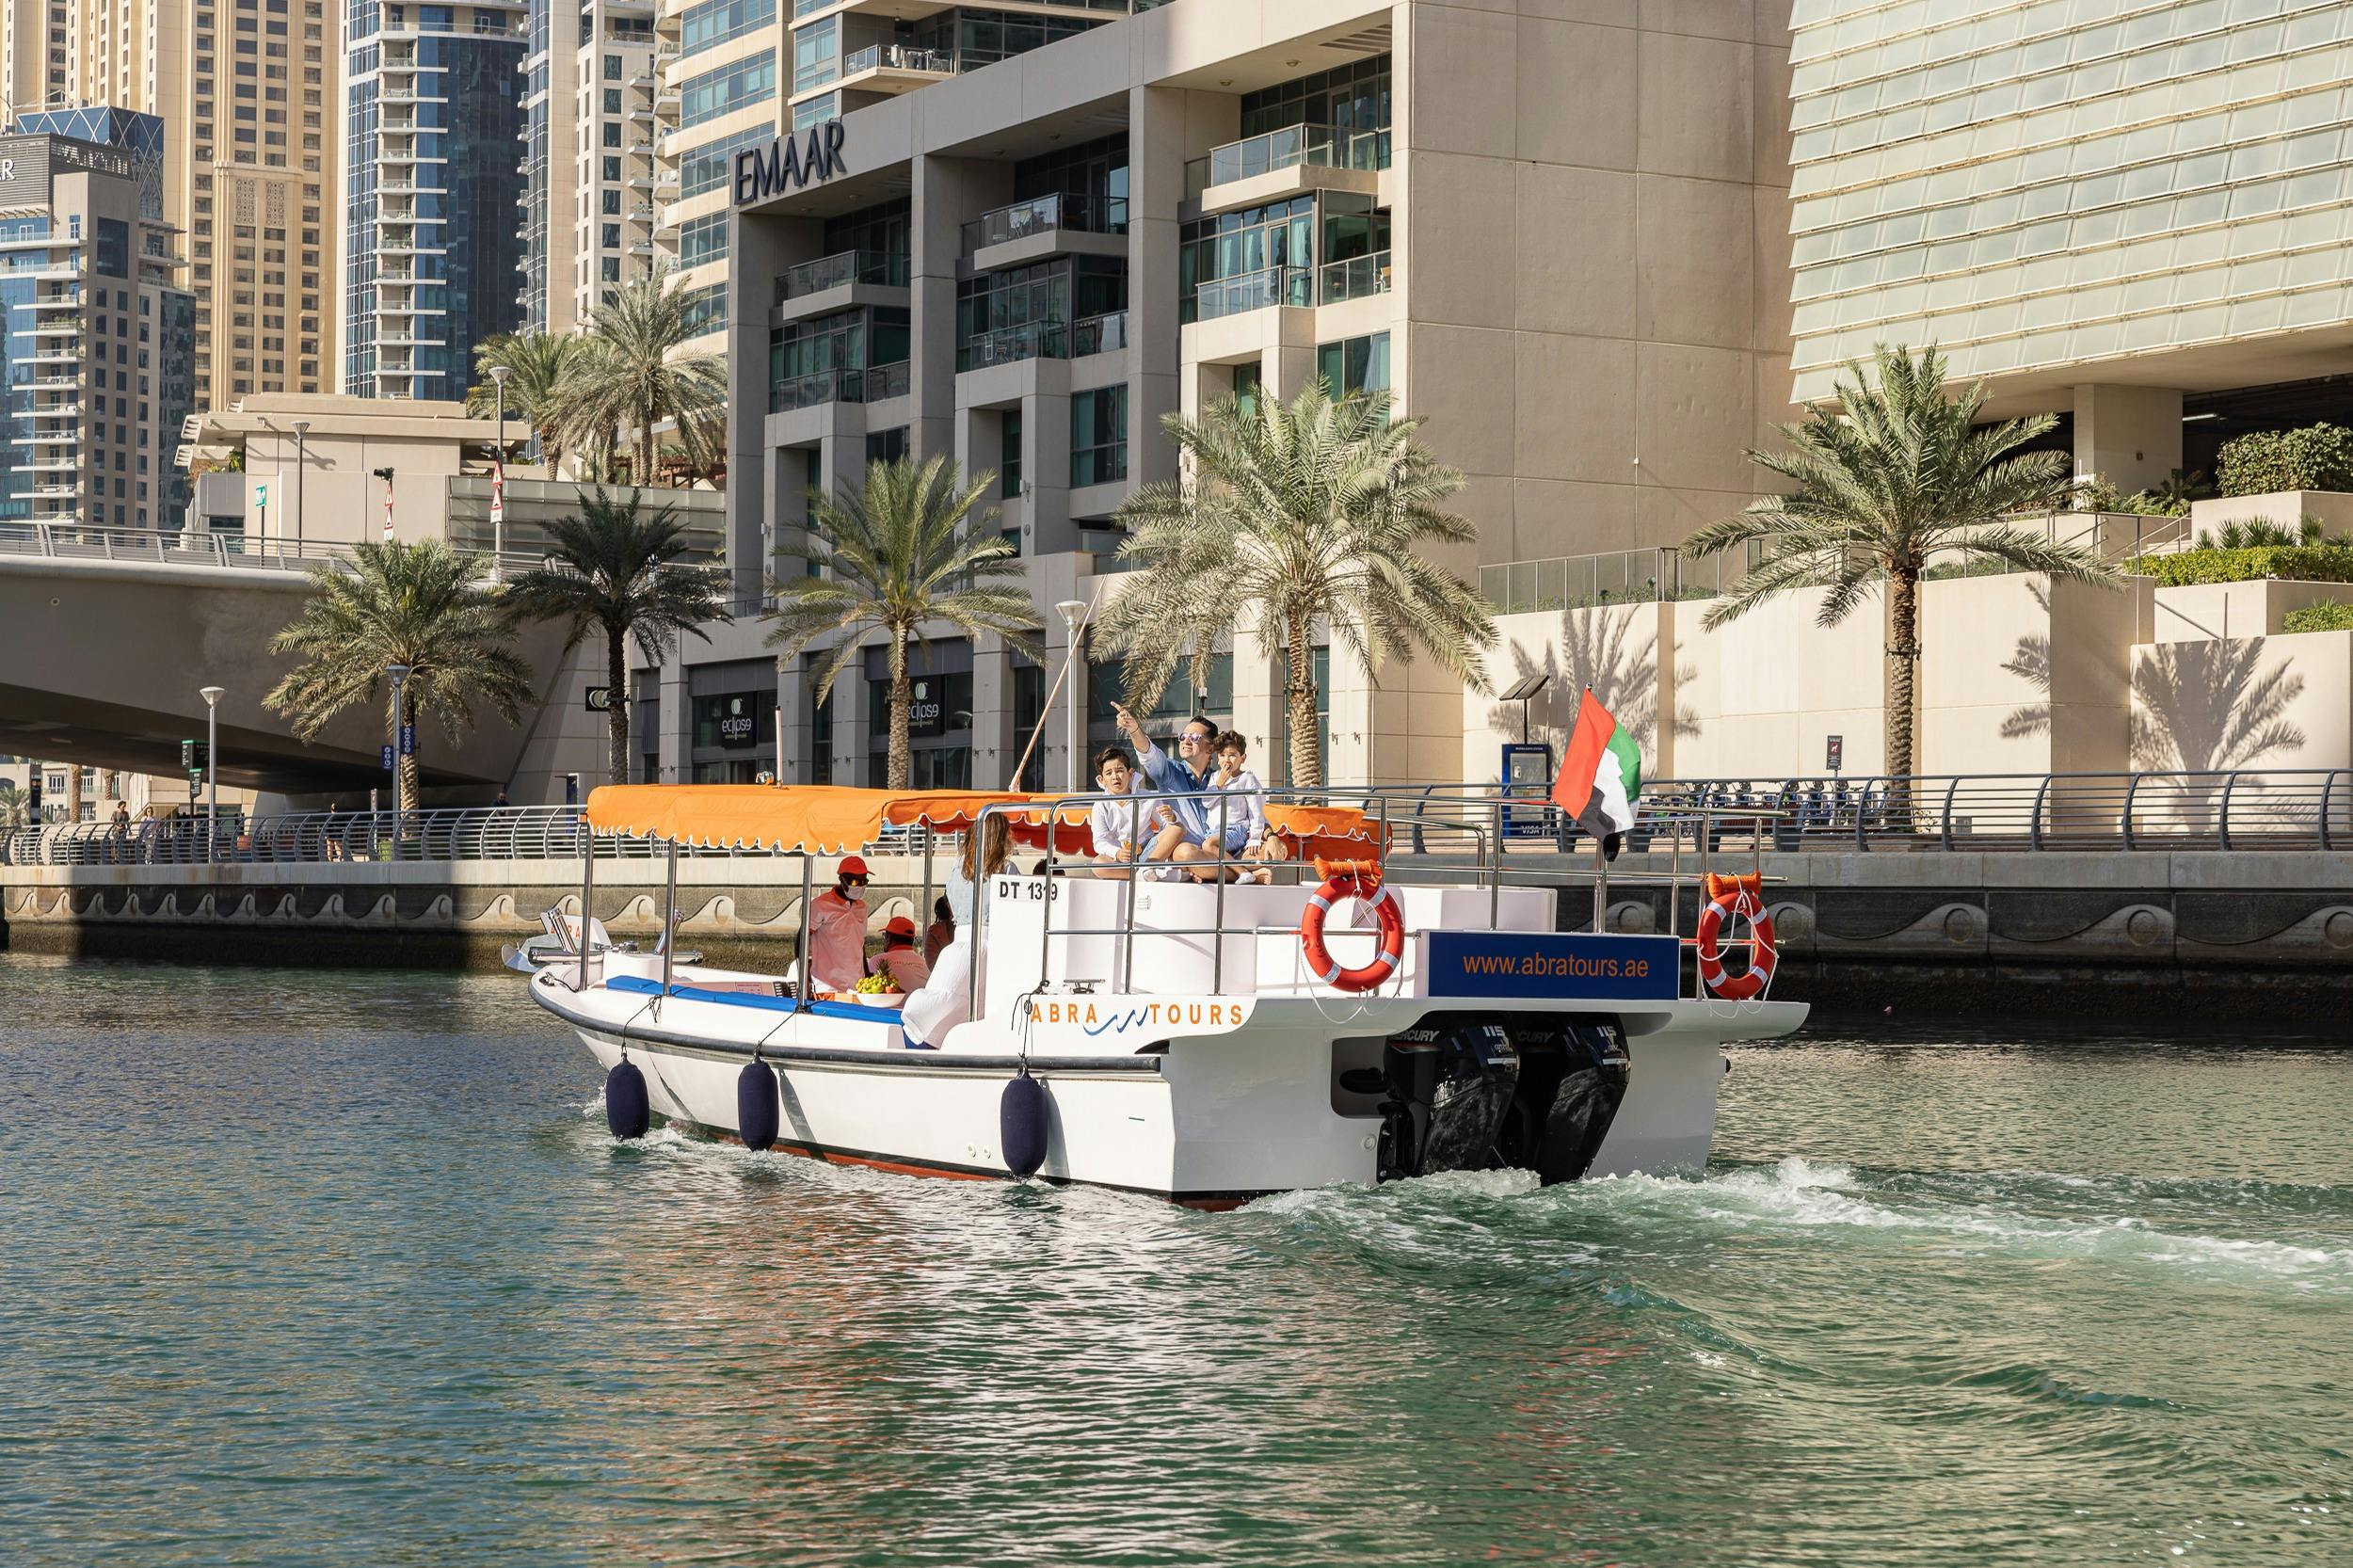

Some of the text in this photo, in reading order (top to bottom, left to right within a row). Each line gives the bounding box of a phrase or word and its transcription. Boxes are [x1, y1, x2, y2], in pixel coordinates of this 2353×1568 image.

[0, 158, 16, 181] R
[734, 120, 846, 205] EMAAR
[722, 716, 752, 741] eclipse
[1000, 881, 1020, 900] DT
[1463, 952, 1649, 978] www.abratours.ae
[1031, 1003, 1242, 1025] ABRA TOURS
[1392, 1030, 1440, 1043] ERCURY
[1482, 1025, 1506, 1037] 115
[1516, 1031, 1556, 1044] CURY
[1596, 1026, 1617, 1037] 115
